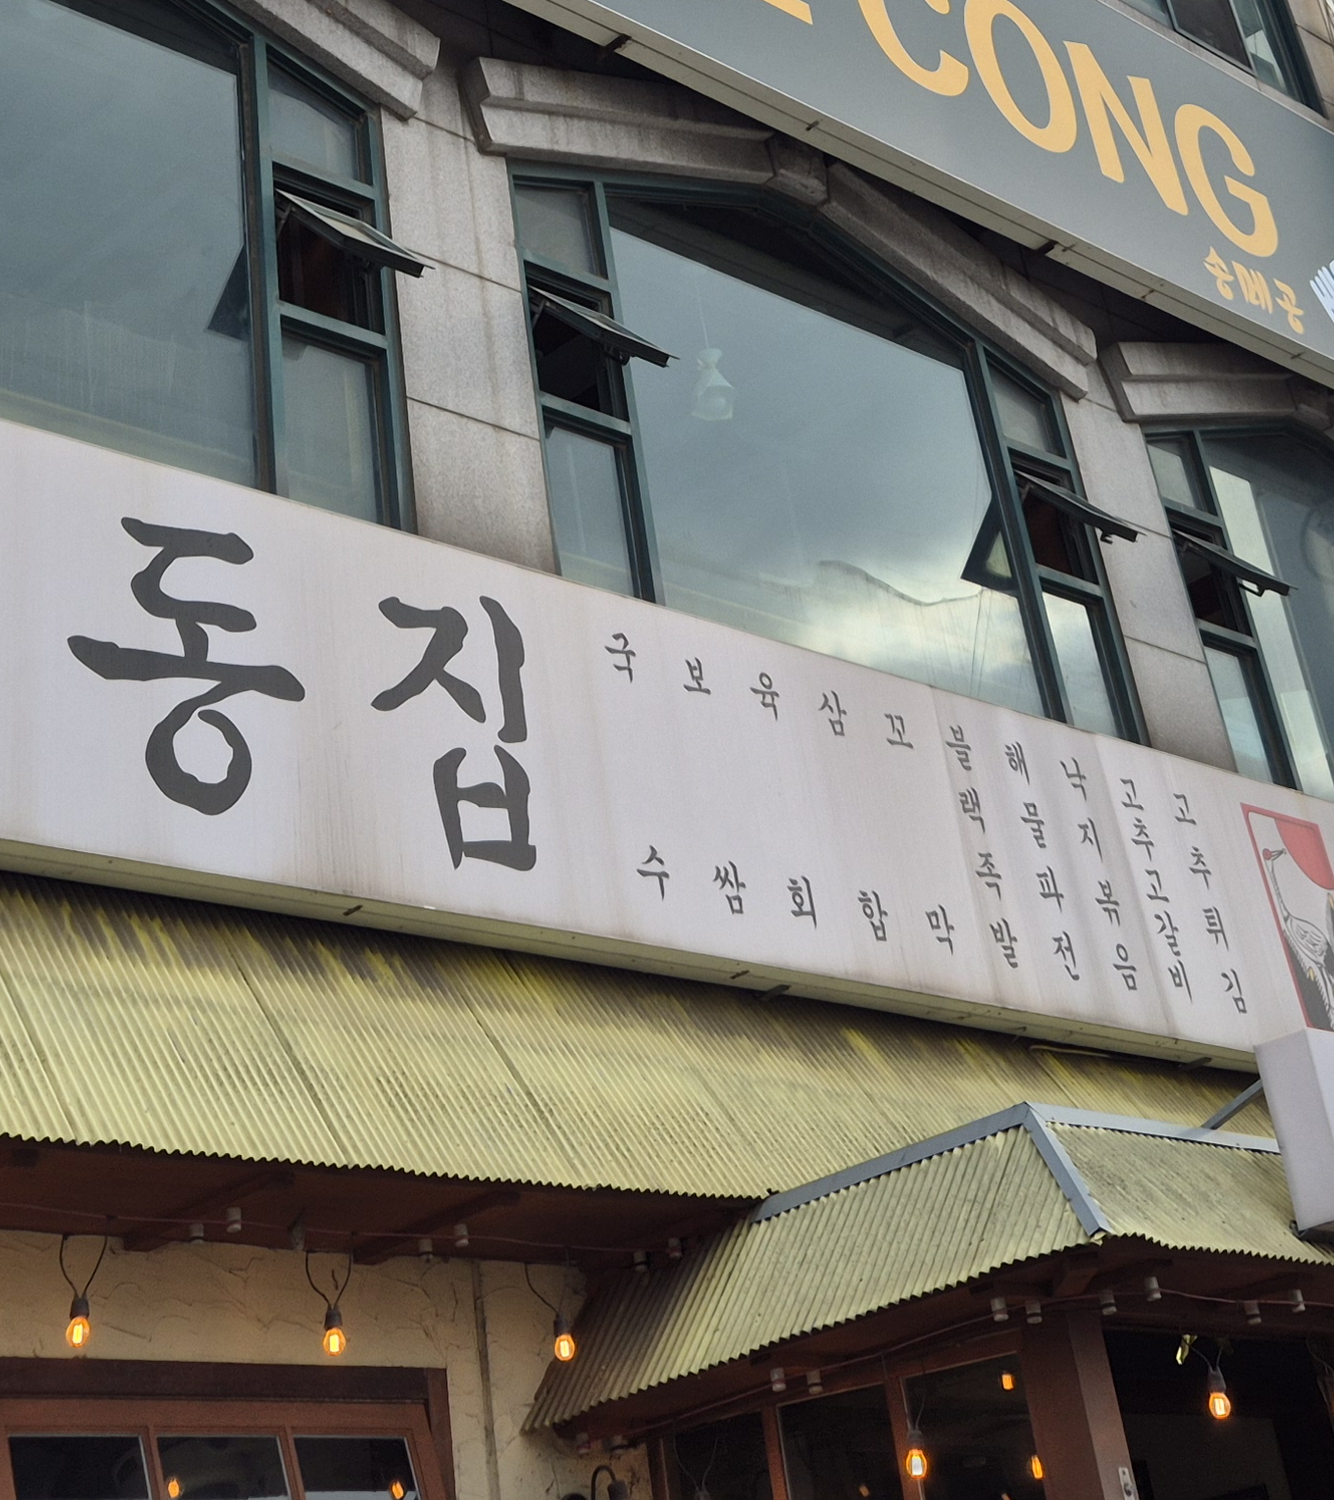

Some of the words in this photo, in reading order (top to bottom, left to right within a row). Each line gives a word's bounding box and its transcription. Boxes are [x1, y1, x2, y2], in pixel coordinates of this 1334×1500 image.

[1203, 246, 1304, 334] 송메공
[945, 724, 1018, 969] 블랙족발
[1005, 741, 1079, 981] 해물파전
[1060, 757, 1137, 991] 낙지볶음
[1120, 778, 1193, 1004] 고추고갈비
[1173, 793, 1247, 1014] 고추튀김
